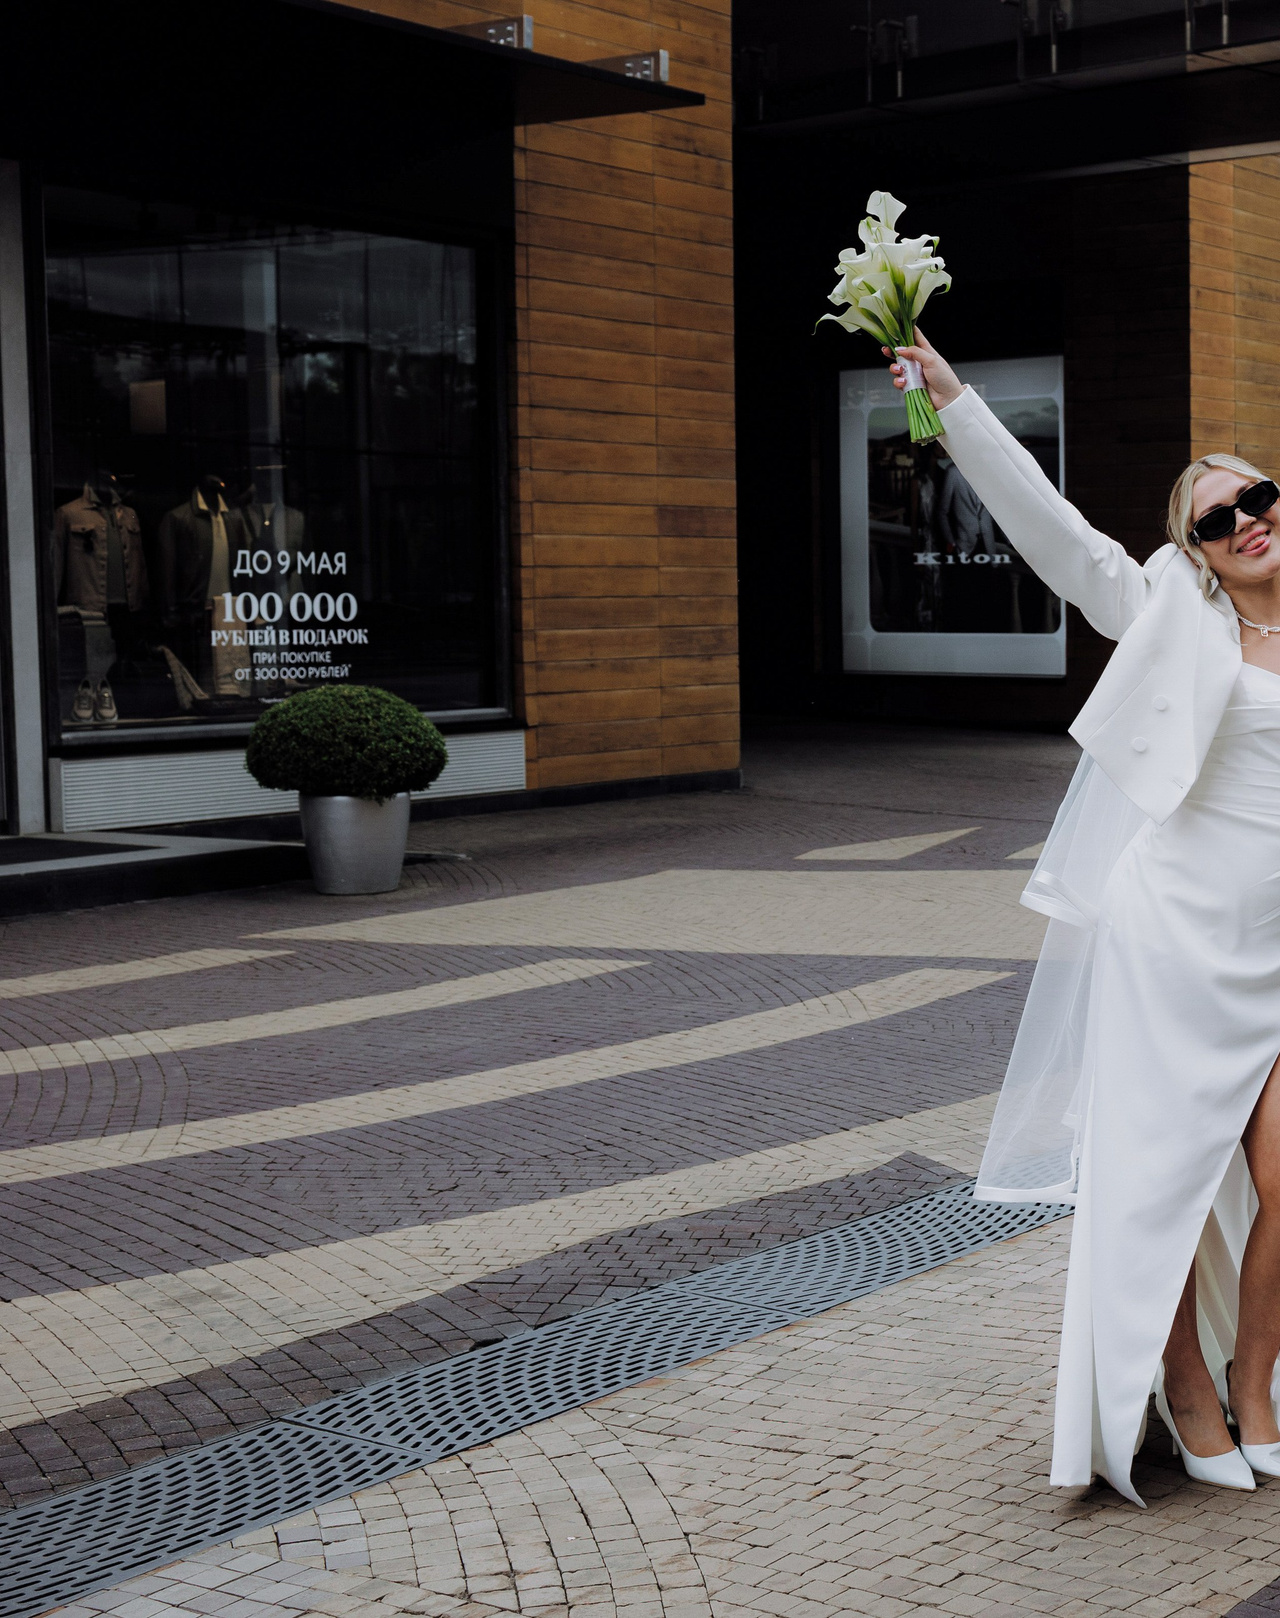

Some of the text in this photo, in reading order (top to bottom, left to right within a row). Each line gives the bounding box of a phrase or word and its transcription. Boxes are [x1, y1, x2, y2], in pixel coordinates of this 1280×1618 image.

[233, 550, 347, 577] ДО 9 МАЯ
[913, 551, 1012, 565] Kiton
[222, 592, 358, 623] 100 000
[211, 626, 369, 646] РУБЛЕЙ В ПОДАРОК
[253, 651, 332, 664] ПРИ ПОКУПКЕ
[234, 668, 251, 680] ОТ
[254, 667, 278, 680] 300
[280, 666, 307, 679] 000
